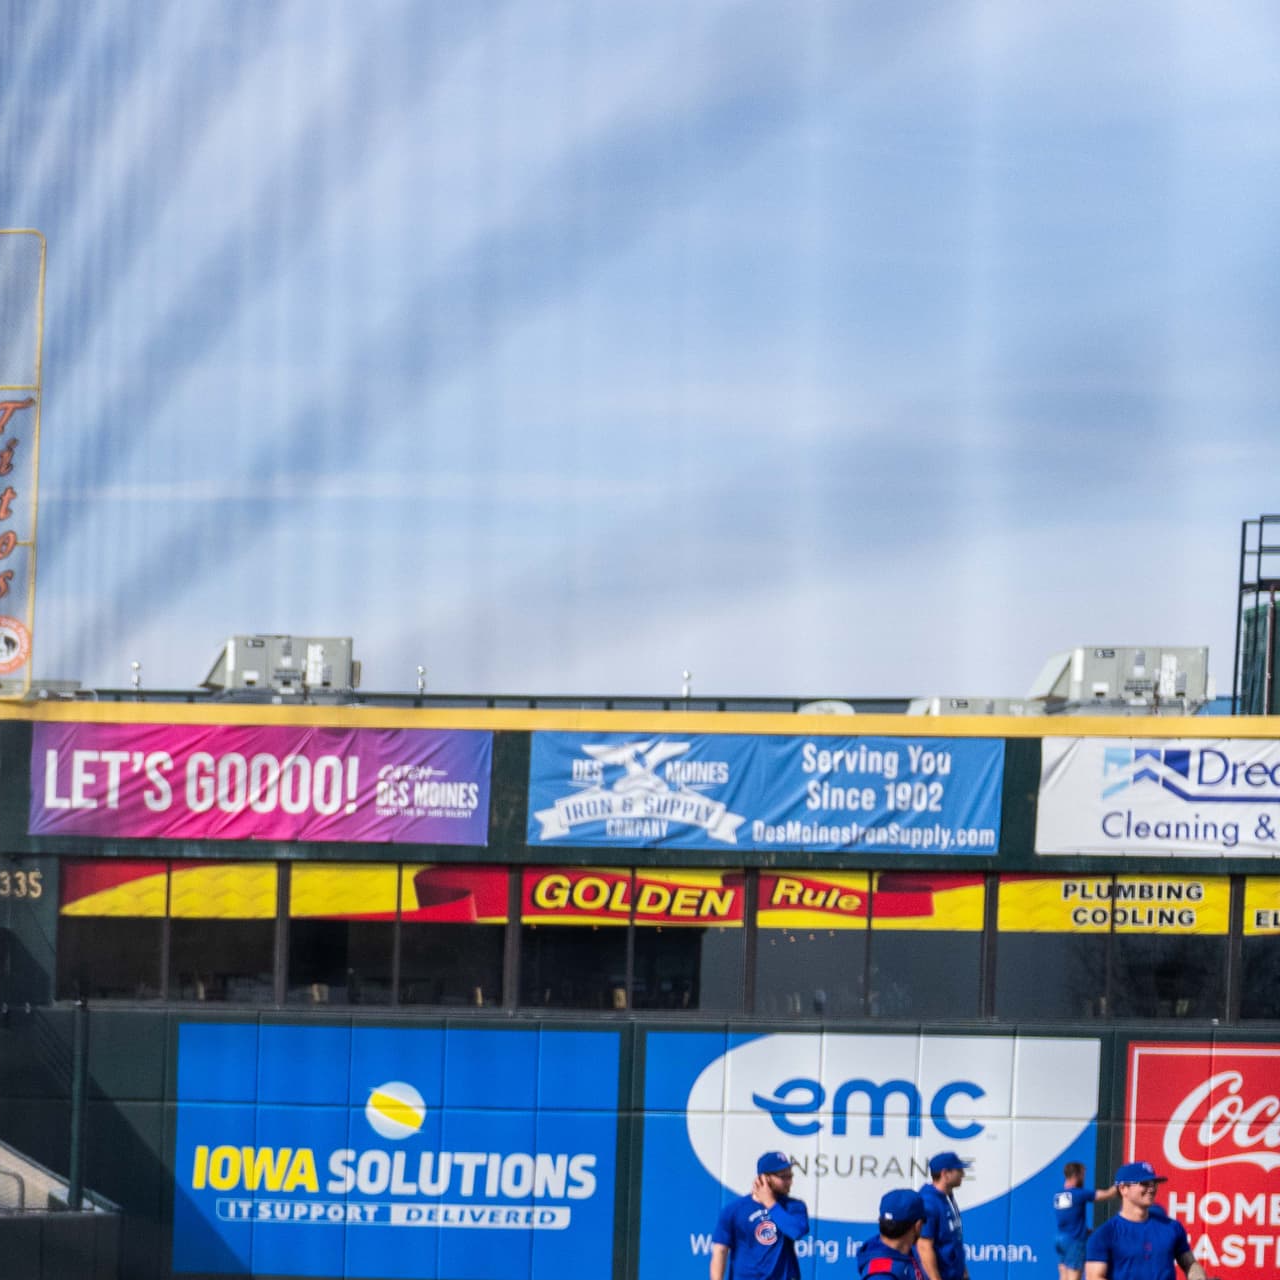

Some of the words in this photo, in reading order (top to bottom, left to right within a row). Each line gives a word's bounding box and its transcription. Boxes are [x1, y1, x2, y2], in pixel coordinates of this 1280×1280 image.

[665, 760, 730, 784] MOINES
[801, 742, 900, 779] Serving
[907, 744, 953, 776] You
[43, 748, 174, 813] LET'S
[185, 751, 359, 815] GOOOO!
[375, 780, 410, 807] DES
[413, 781, 480, 810] MOINES
[805, 779, 877, 812] Since
[884, 782, 945, 813] 1902
[563, 798, 613, 822] IRON
[643, 797, 717, 823] SUPPLY
[605, 816, 670, 838] COMPANY
[751, 819, 996, 850] DesMoinesIronSupply.com
[1101, 809, 1241, 848] Cleaning
[1253, 813, 1277, 842] &
[533, 874, 736, 918] GOLDEN
[769, 876, 863, 911] Rule
[1061, 882, 1205, 901] PLUMBING
[1071, 908, 1197, 928] COOLING
[751, 1077, 987, 1140] emc
[192, 1144, 320, 1194] IOWA
[326, 1148, 599, 1200] SOLUTIONS
[226, 1200, 255, 1219] IT
[257, 1202, 380, 1223] SUPPORT
[404, 1206, 558, 1226] DELIVERED
